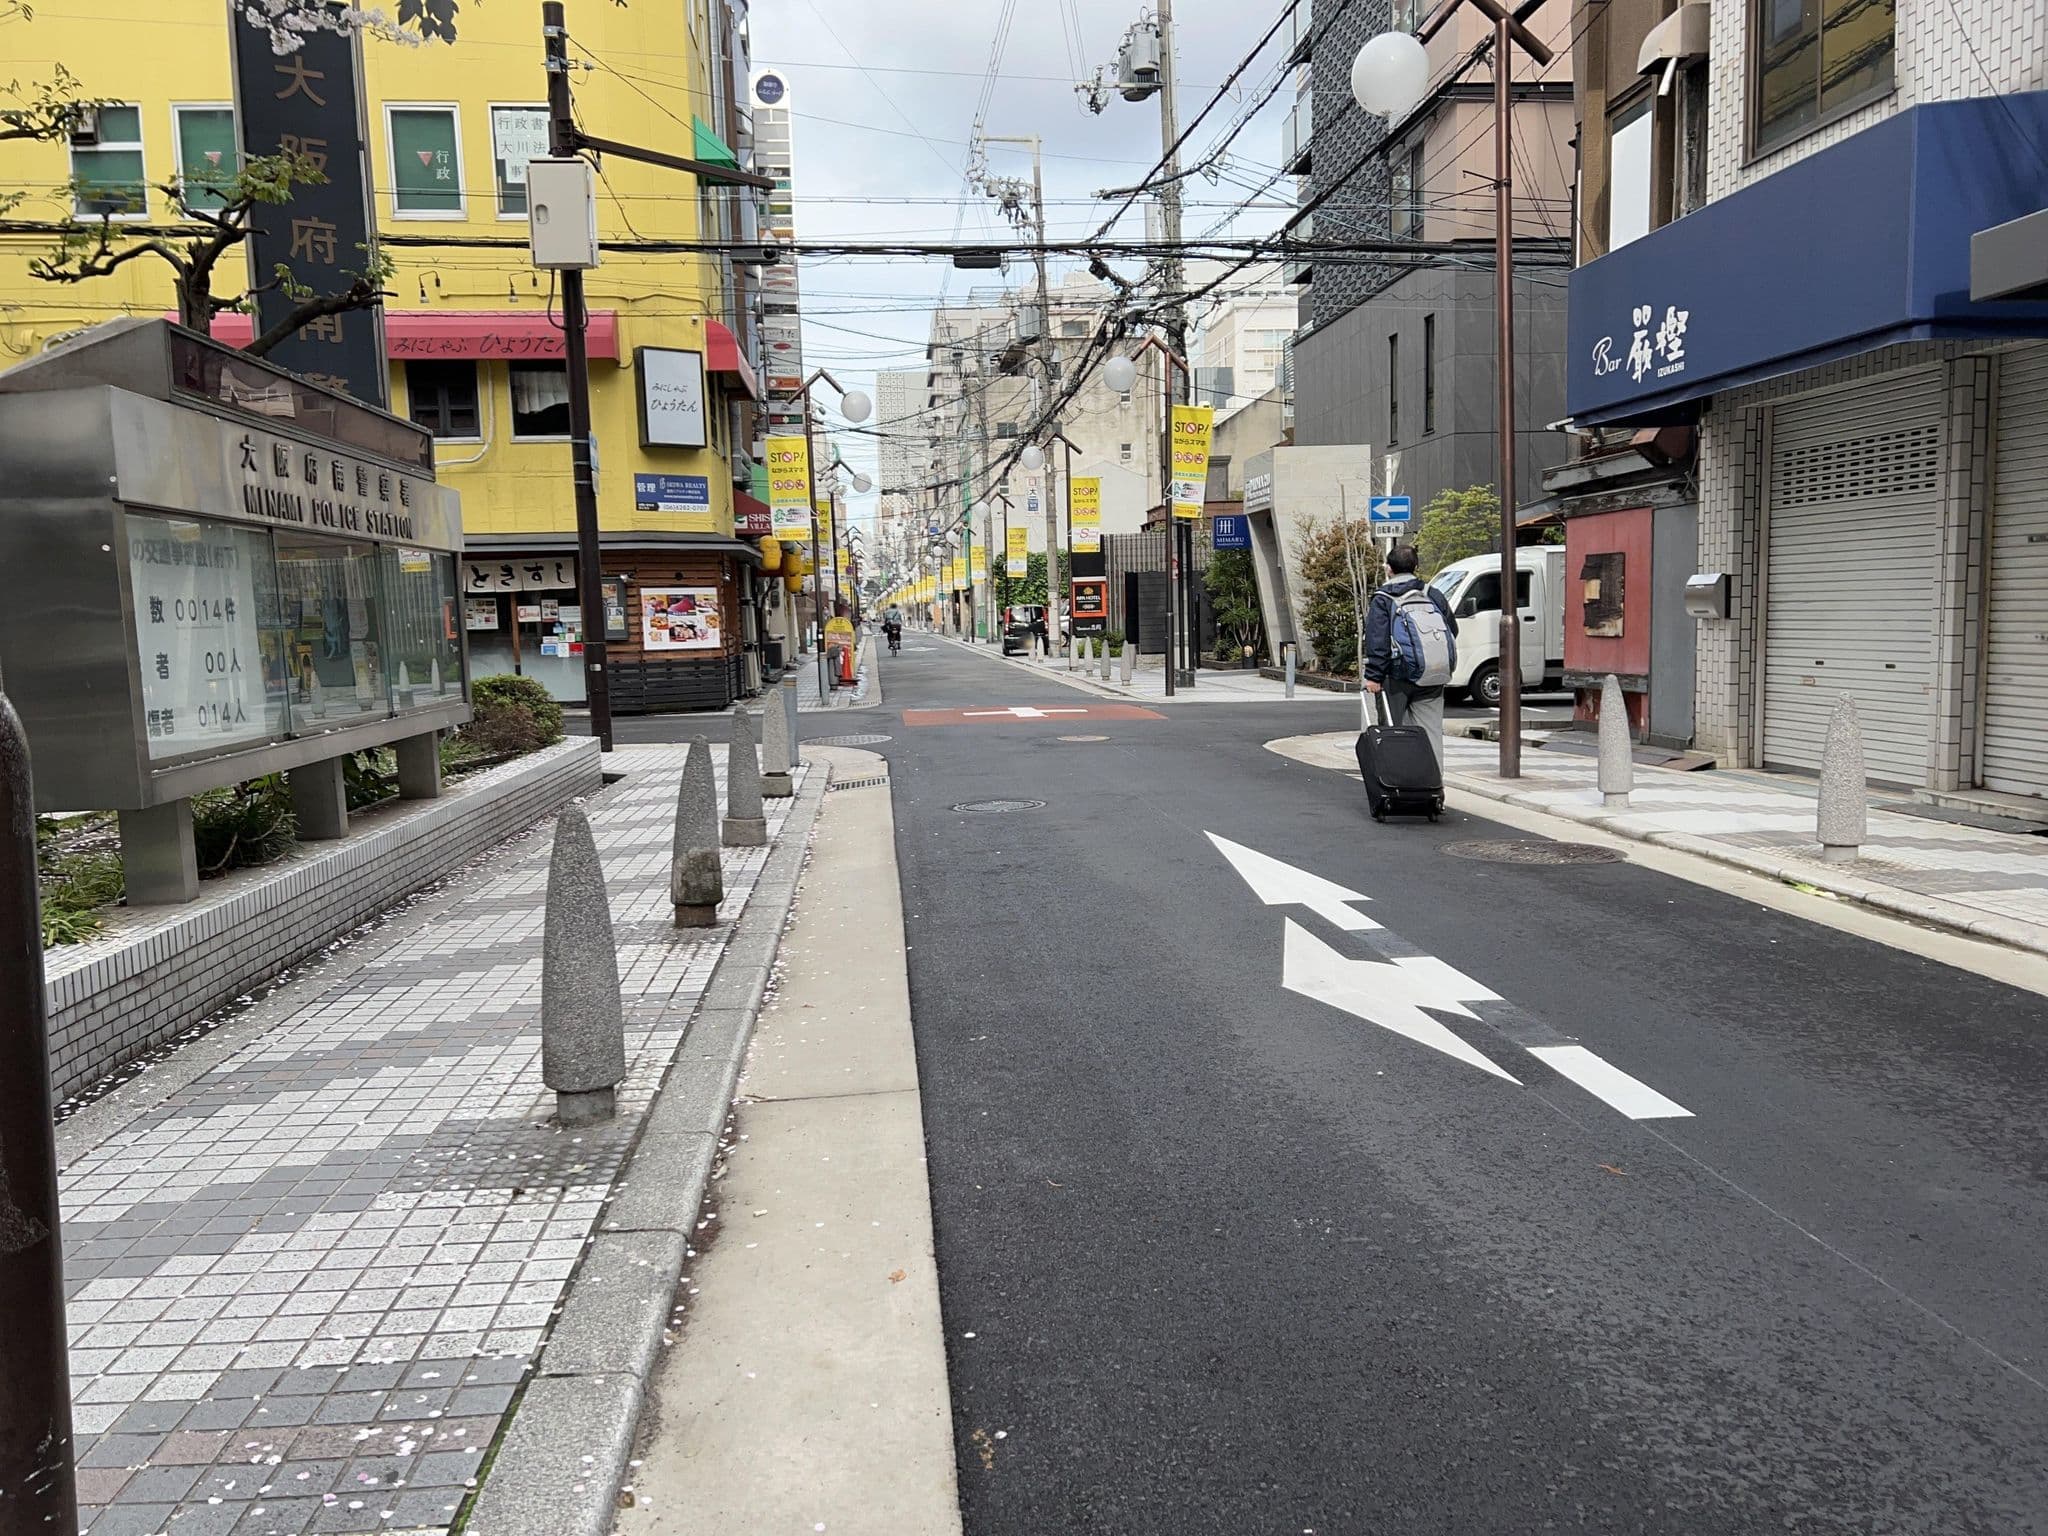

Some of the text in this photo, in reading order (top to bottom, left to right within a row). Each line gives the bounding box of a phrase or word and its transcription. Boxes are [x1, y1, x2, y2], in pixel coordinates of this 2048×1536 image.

[498, 117, 546, 131] 行政書
[500, 140, 546, 155] 大川法
[435, 149, 451, 181] 行政
[393, 335, 469, 354] みにしゃぶ
[1592, 336, 1622, 376] Bar
[1657, 361, 1685, 378] IZUKASHI
[650, 398, 698, 413] ひょうたん
[1174, 420, 1210, 435] STOP!
[770, 451, 804, 463] STOP!
[240, 434, 410, 507] 大阪府南警察署
[243, 484, 413, 540] MINAMI POLICE STATION
[470, 561, 570, 588] ときすし
[156, 652, 170, 680] 者
